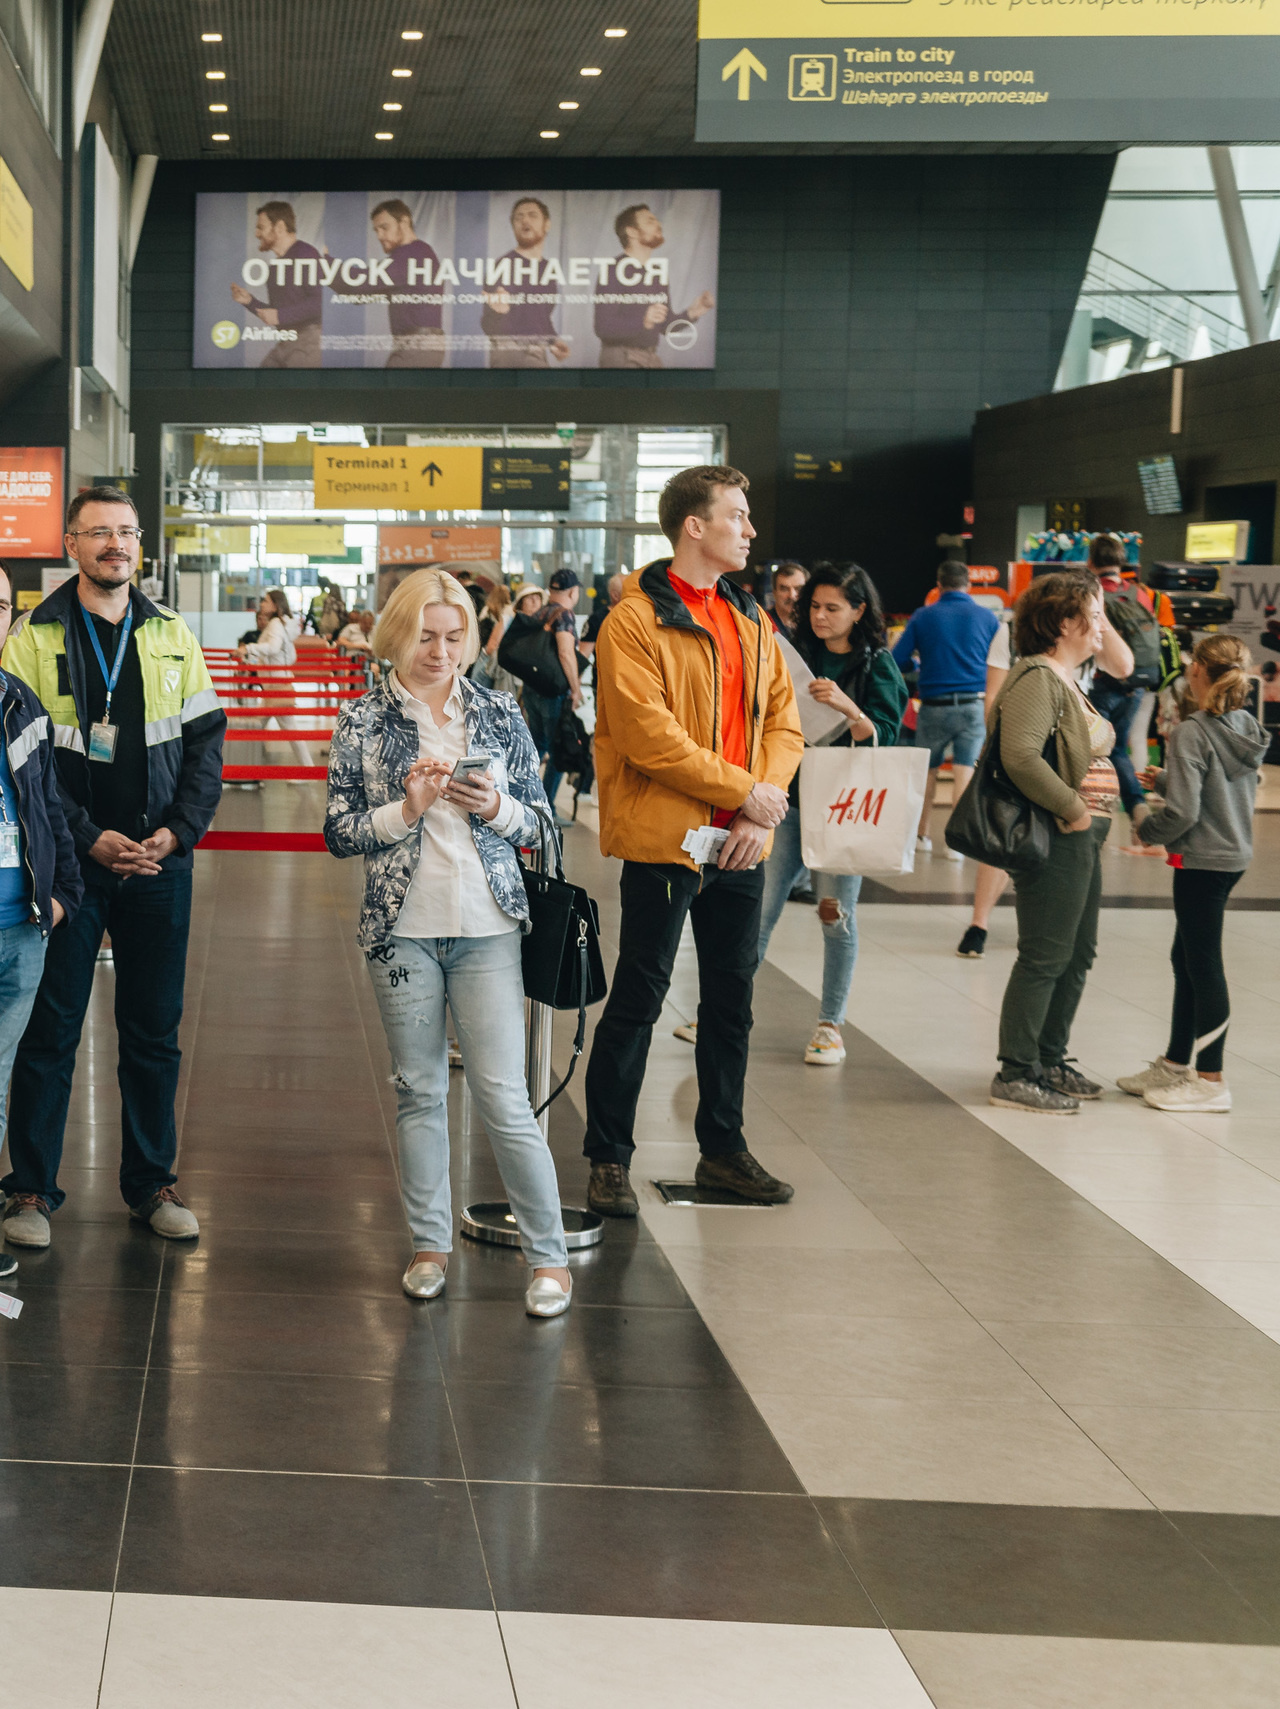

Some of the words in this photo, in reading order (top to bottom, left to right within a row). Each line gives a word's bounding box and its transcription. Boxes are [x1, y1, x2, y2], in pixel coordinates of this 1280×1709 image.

[844, 47, 892, 63] Train
[896, 48, 917, 63] to
[920, 46, 955, 65] city
[842, 68, 964, 86] Электропоезд
[969, 71, 979, 83] в
[984, 70, 1035, 85] город
[920, 91, 1049, 106] электропоезды
[241, 257, 394, 286] ОТПУСК
[407, 257, 669, 287] НАЧИНАЕТСЯ
[214, 326, 237, 344] S7
[241, 326, 298, 342] Airlines
[326, 456, 395, 469] Terminal
[399, 457, 408, 469] 1
[326, 479, 398, 494] Терминал
[403, 480, 410, 492] 1
[827, 787, 888, 827] H&M
[389, 965, 410, 988] 84
